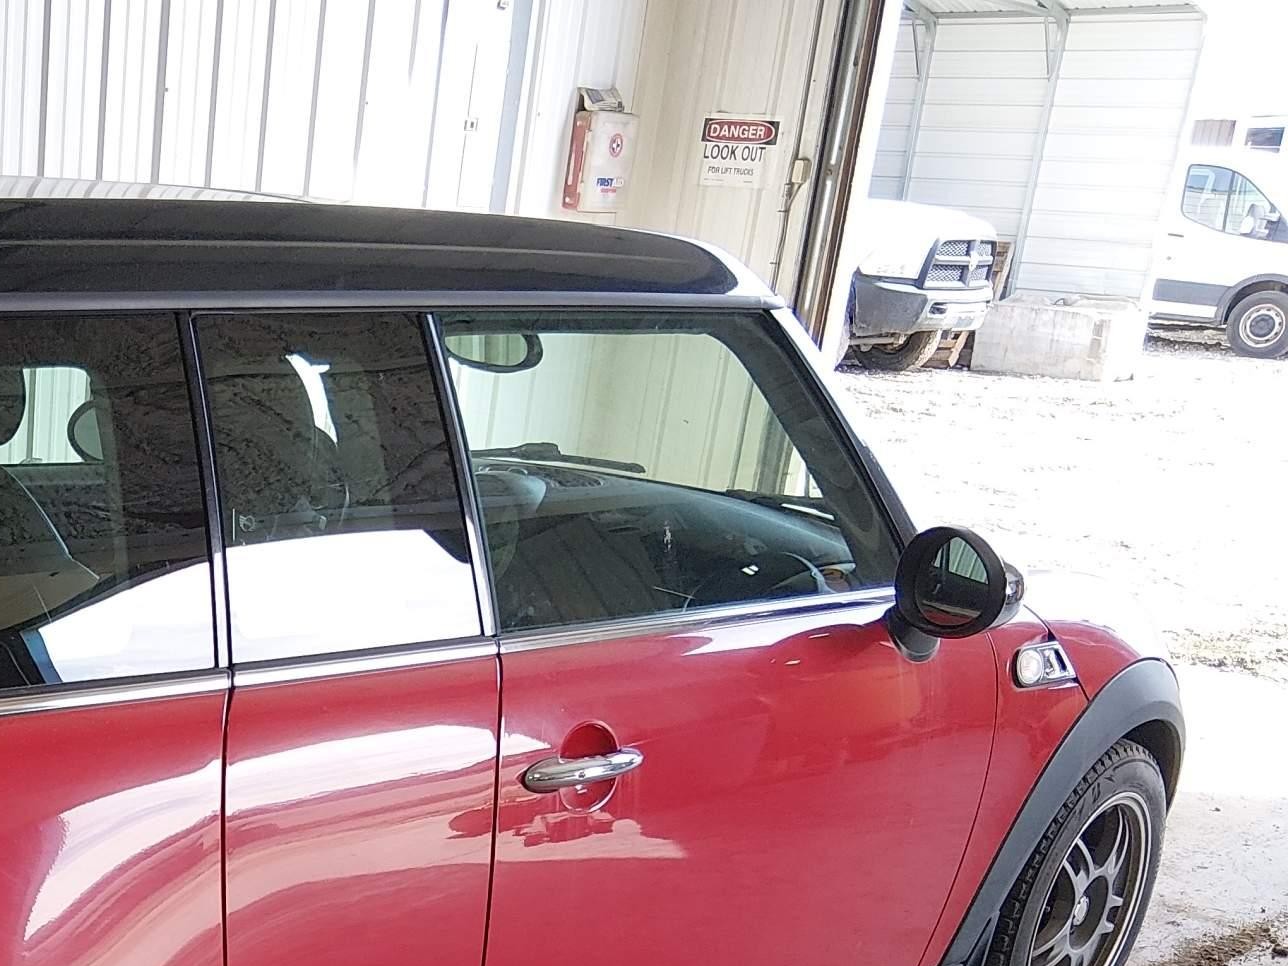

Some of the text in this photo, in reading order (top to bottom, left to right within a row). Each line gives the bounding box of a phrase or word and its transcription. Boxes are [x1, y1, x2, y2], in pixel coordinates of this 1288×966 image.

[709, 123, 766, 139] DANGER
[703, 144, 766, 162] LOOK OUT
[707, 166, 754, 176] FOR LIFT TRUCKS
[596, 177, 614, 188] FIRST
